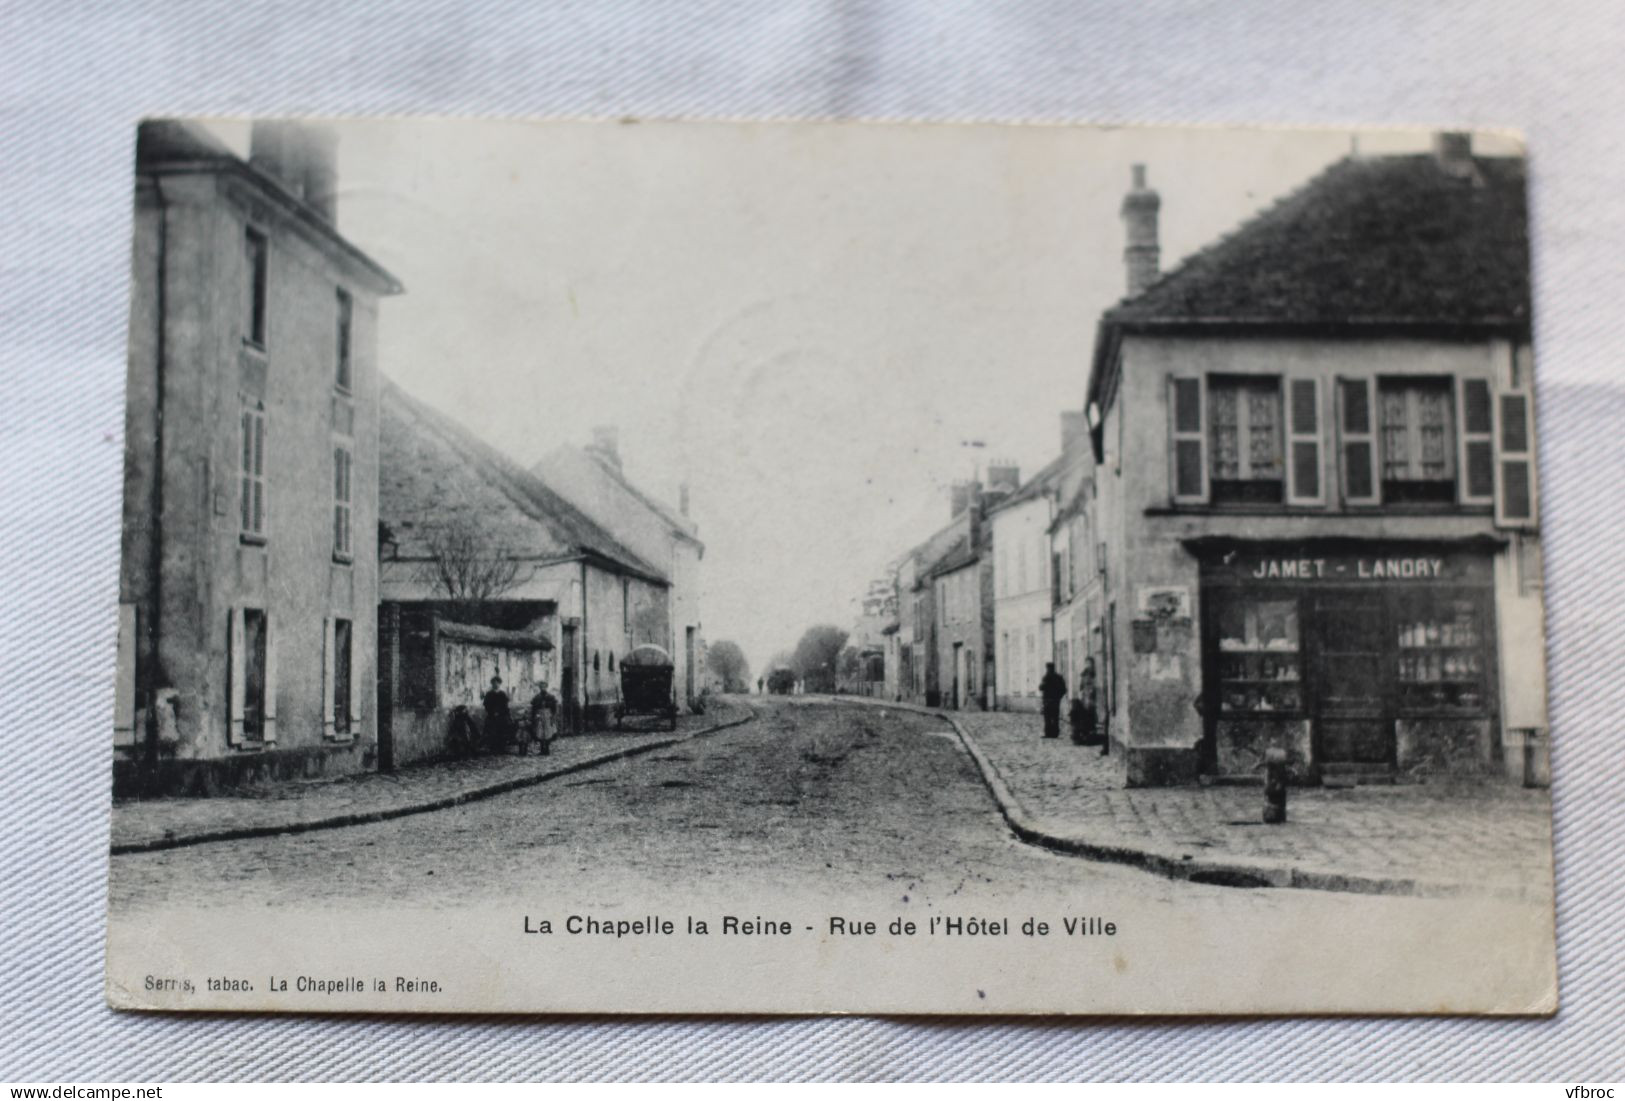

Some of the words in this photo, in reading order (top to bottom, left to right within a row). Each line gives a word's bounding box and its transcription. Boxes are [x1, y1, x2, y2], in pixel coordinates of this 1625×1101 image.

[1253, 559, 1326, 578] JAMET
[1358, 558, 1442, 578] LANDRY
[524, 915, 553, 935] La
[565, 915, 675, 939] Chapelle
[688, 915, 709, 935] la
[722, 915, 792, 936] Reine
[829, 916, 876, 936] Rue
[888, 916, 917, 936] de
[928, 915, 1008, 936] l'Hôtel
[1020, 916, 1050, 937] de
[1063, 916, 1118, 937] Ville
[207, 976, 253, 992] tabac.
[269, 976, 288, 992] La
[297, 976, 364, 996] Chapelle
[374, 976, 387, 992] la
[395, 977, 442, 993] Reine.
